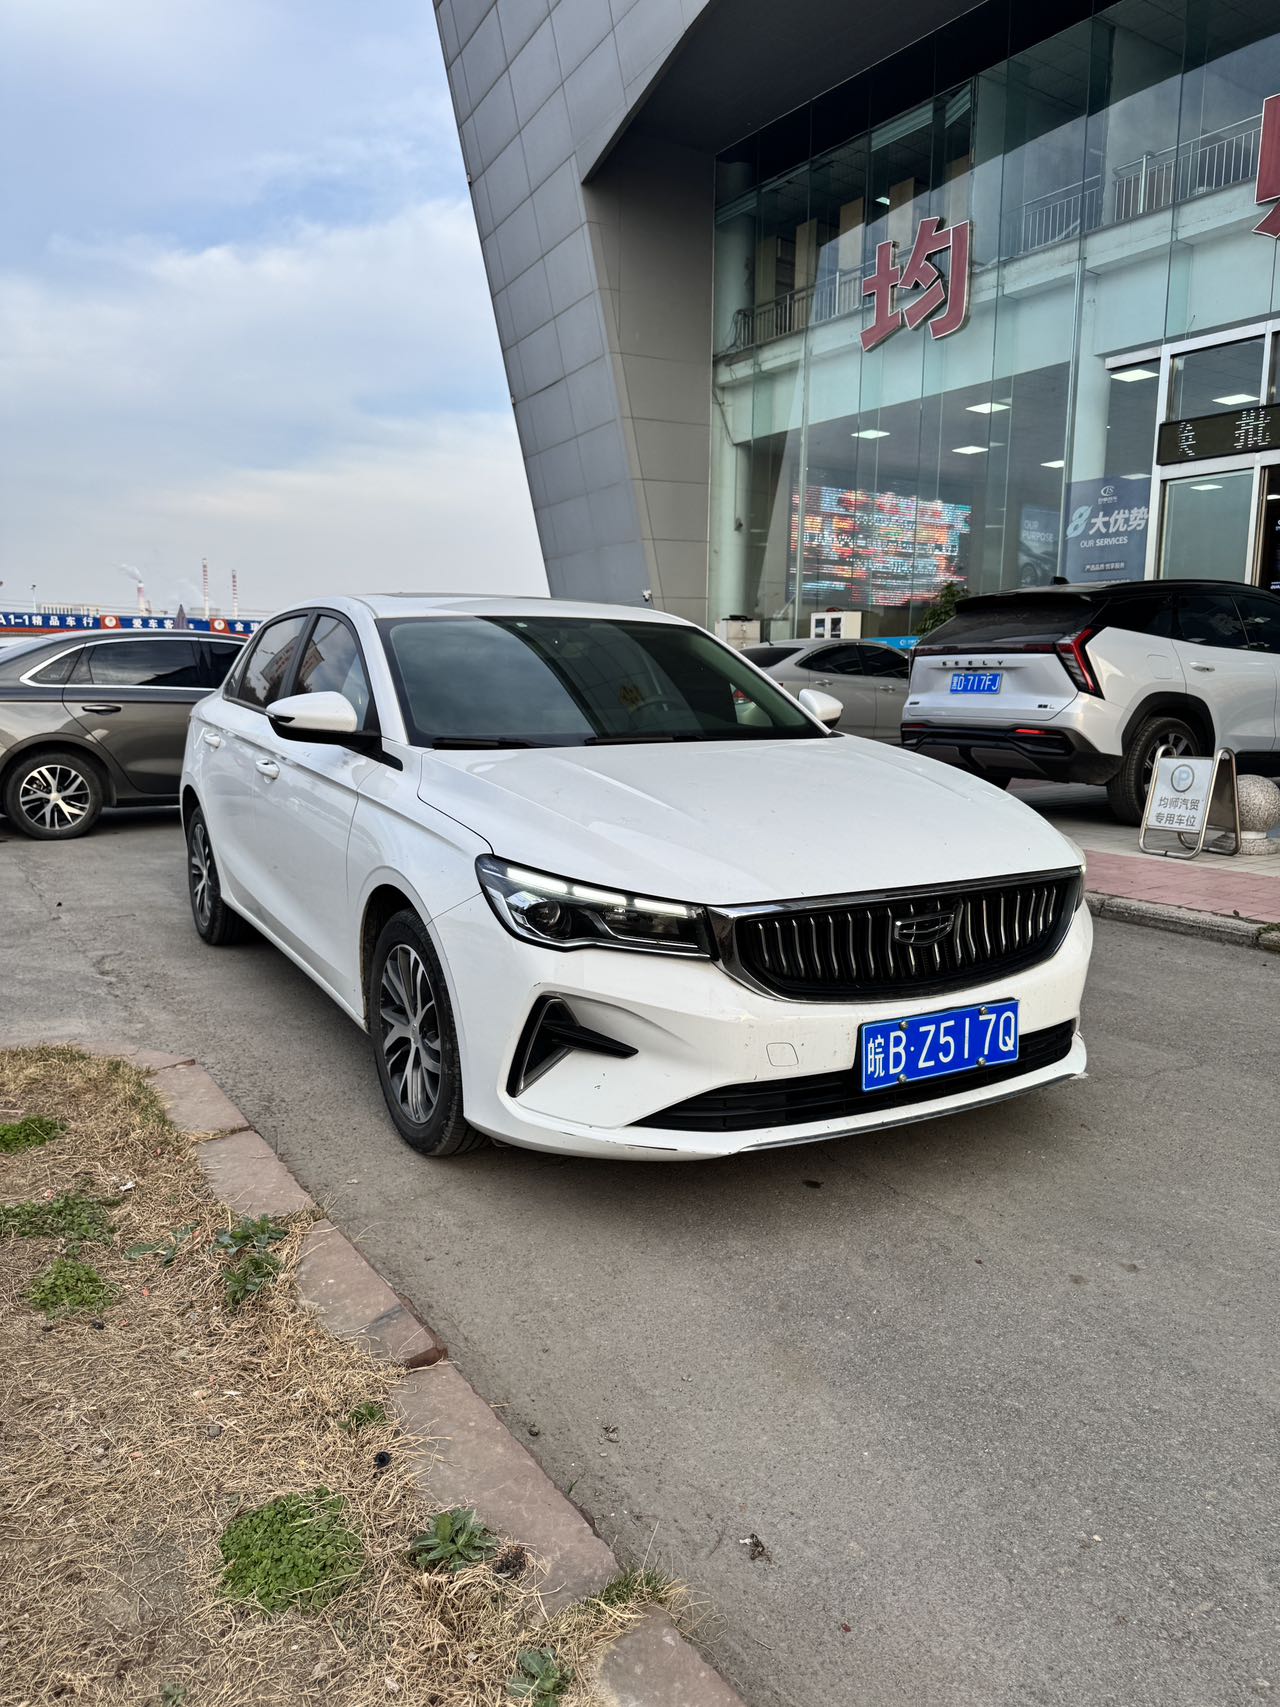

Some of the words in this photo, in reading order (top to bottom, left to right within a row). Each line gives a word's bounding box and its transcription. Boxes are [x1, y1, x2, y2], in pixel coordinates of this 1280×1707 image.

[859, 216, 970, 352] 均
[1080, 539, 1095, 549] OUR
[1095, 536, 1129, 547] SERVICES
[132, 618, 195, 629] 爱车客
[1158, 796, 1200, 811] 均师汽贸
[1155, 812, 1197, 827] 专用车位
[867, 1011, 1015, 1079] 皖B·Z517Q
